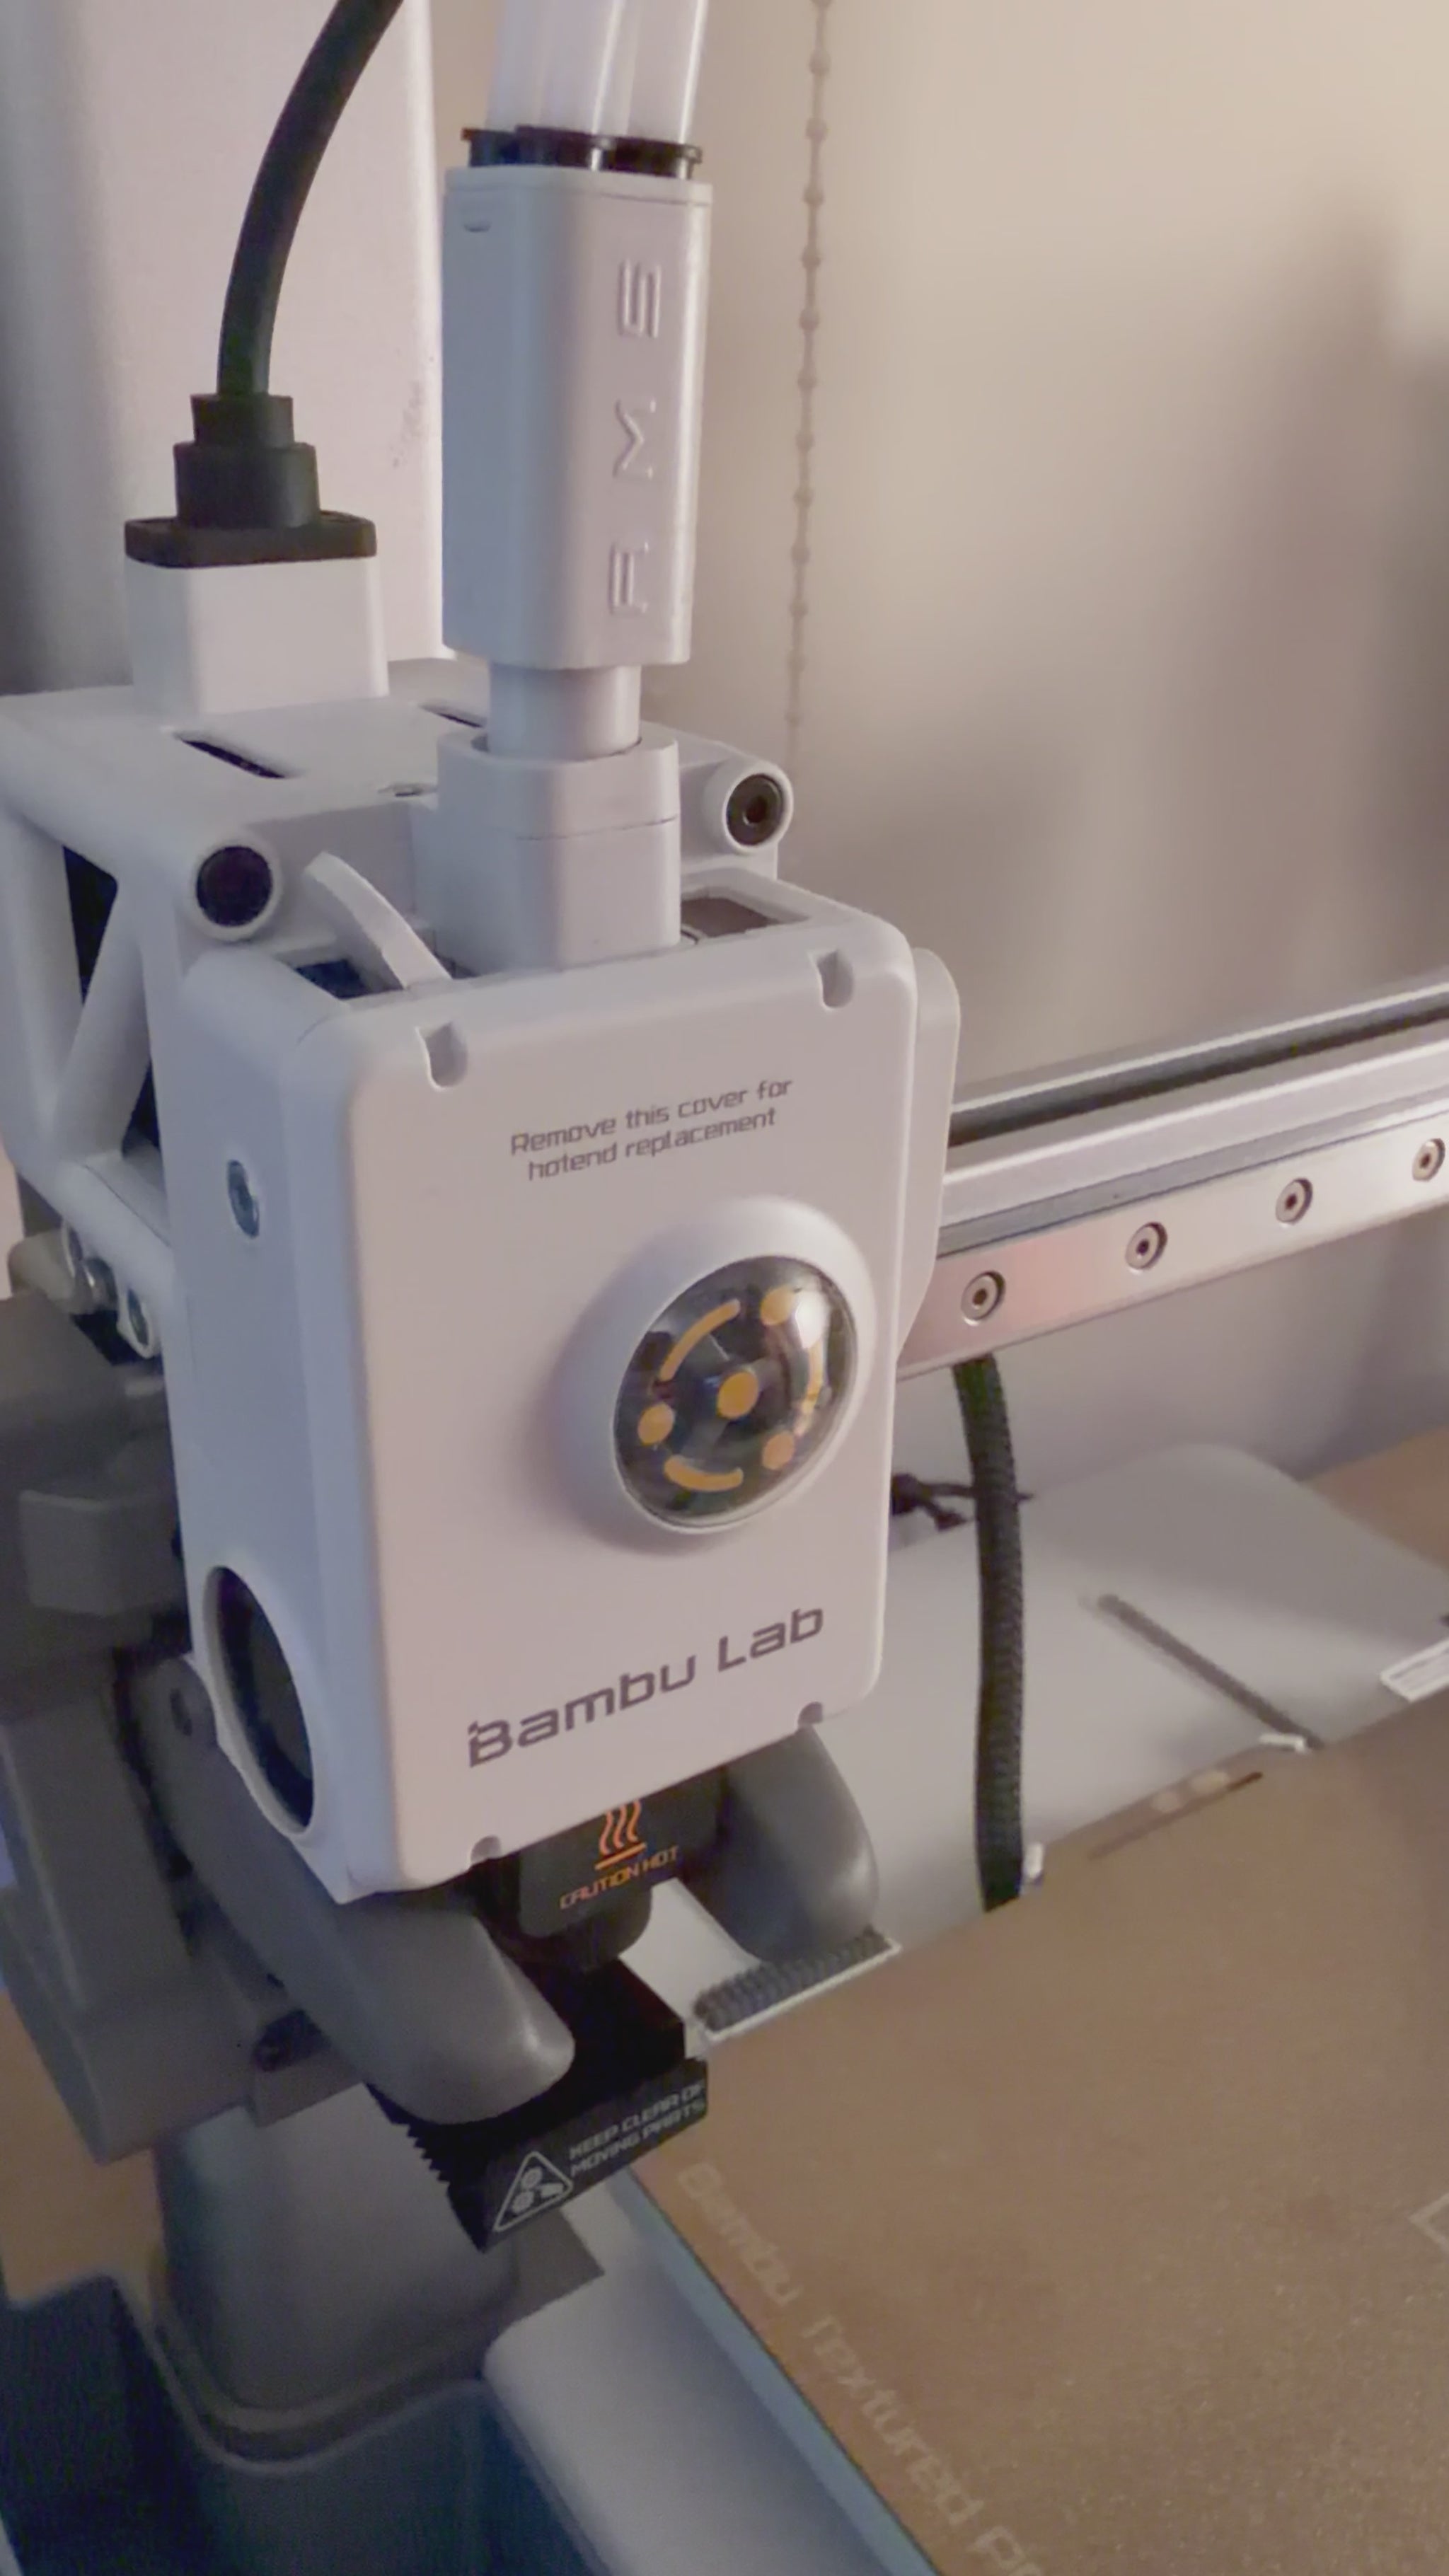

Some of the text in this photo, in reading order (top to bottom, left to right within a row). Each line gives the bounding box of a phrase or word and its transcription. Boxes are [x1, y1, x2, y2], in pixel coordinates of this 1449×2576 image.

[608, 259, 662, 615] AMS
[511, 1079, 793, 1156] Remove this cover for
[528, 1107, 776, 1181] hotend replacement
[467, 1607, 824, 1769] Bambu Lab
[560, 1845, 679, 1910] CAUTION HOT
[569, 2123, 619, 2161] KEEP
[622, 2092, 679, 2132] CLEAR
[570, 2096, 706, 2178] MOVING PARTS
[676, 2161, 804, 2309] Bambu
[801, 2315, 986, 2526] Textured
